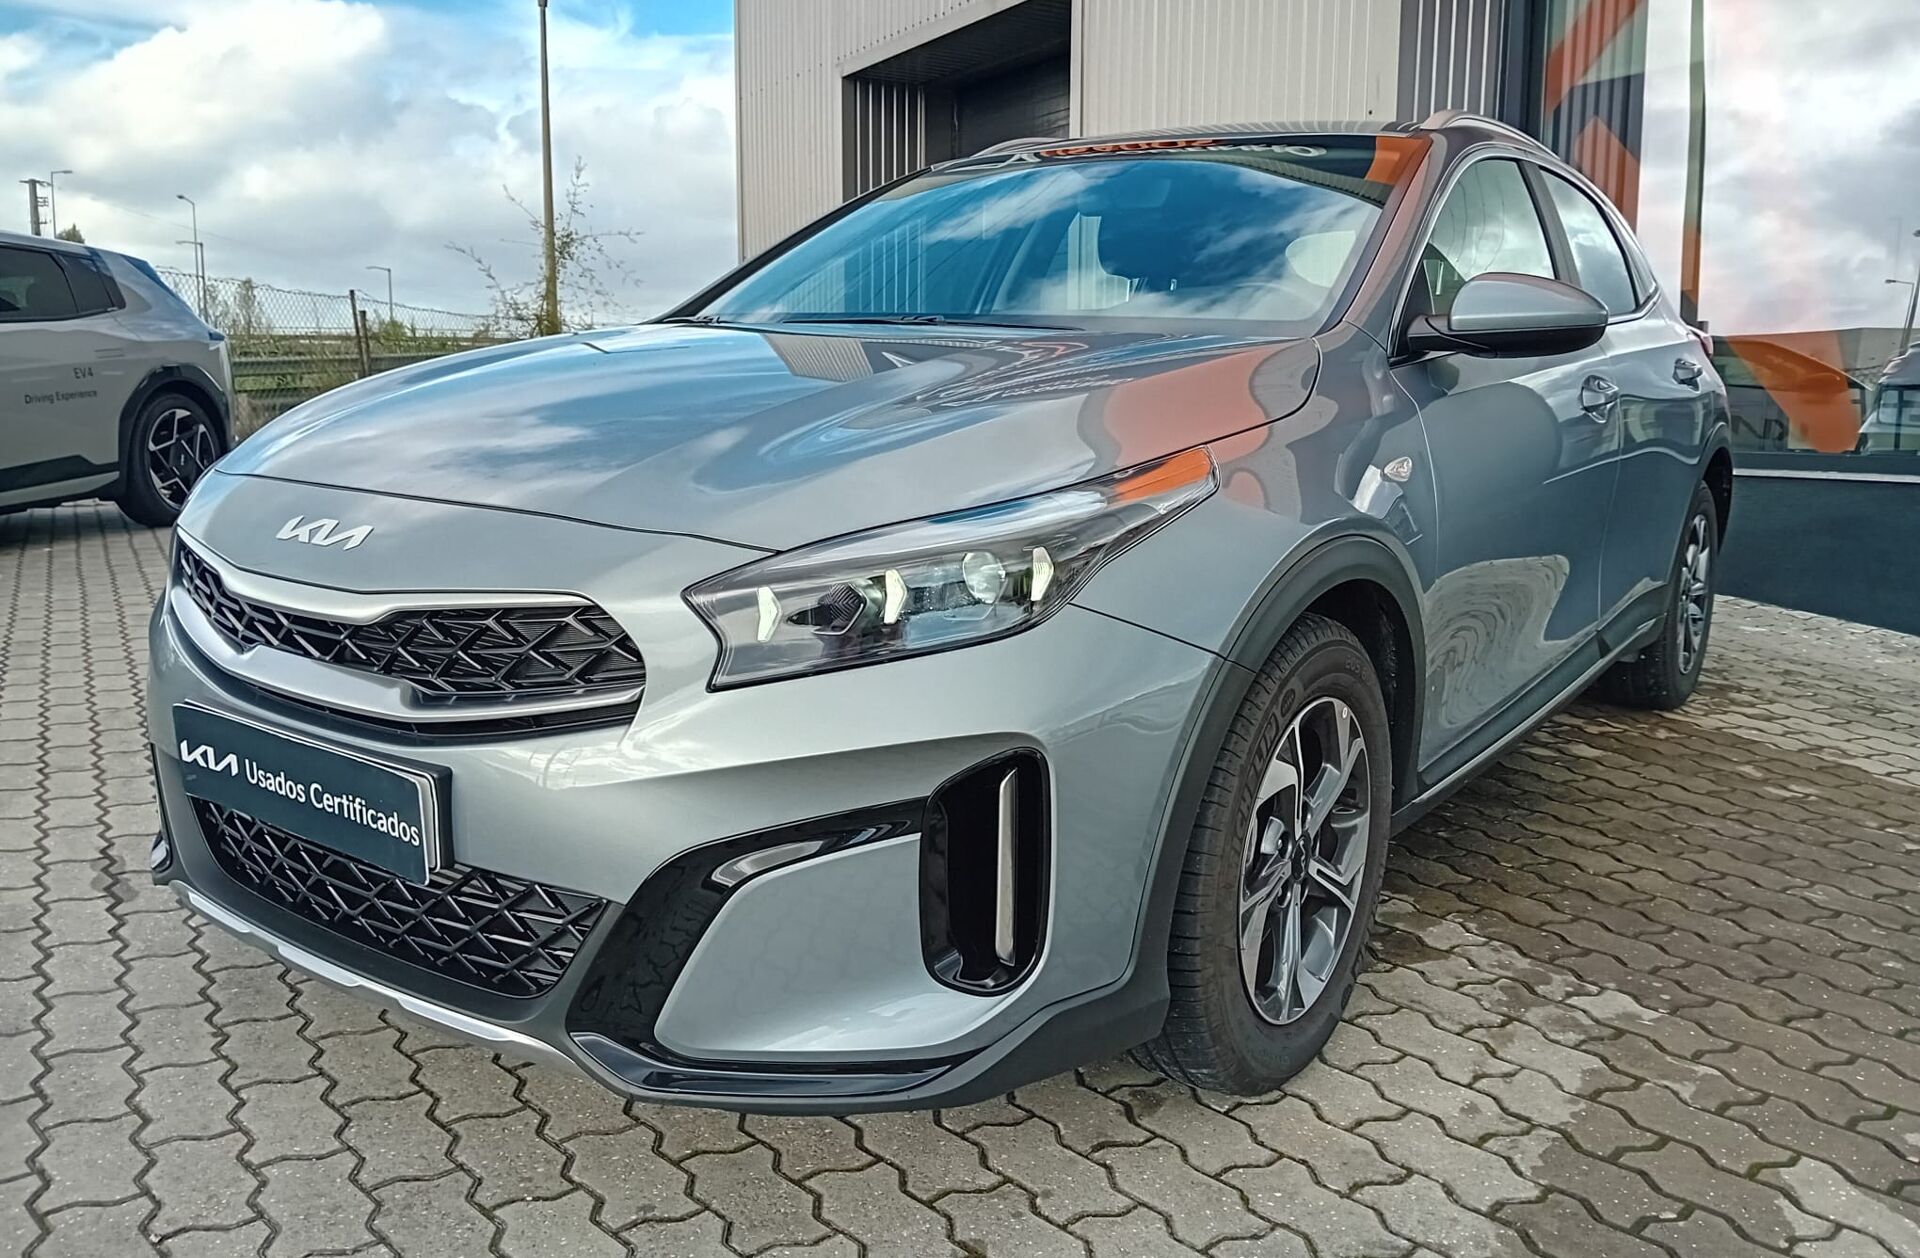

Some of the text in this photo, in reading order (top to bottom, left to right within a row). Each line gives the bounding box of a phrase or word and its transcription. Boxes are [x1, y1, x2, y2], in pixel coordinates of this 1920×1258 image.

[73, 366, 94, 380] EV4
[24, 390, 97, 405] Driving Experience
[275, 515, 374, 551] KIA
[180, 739, 420, 847] KIA Usados Certificados
